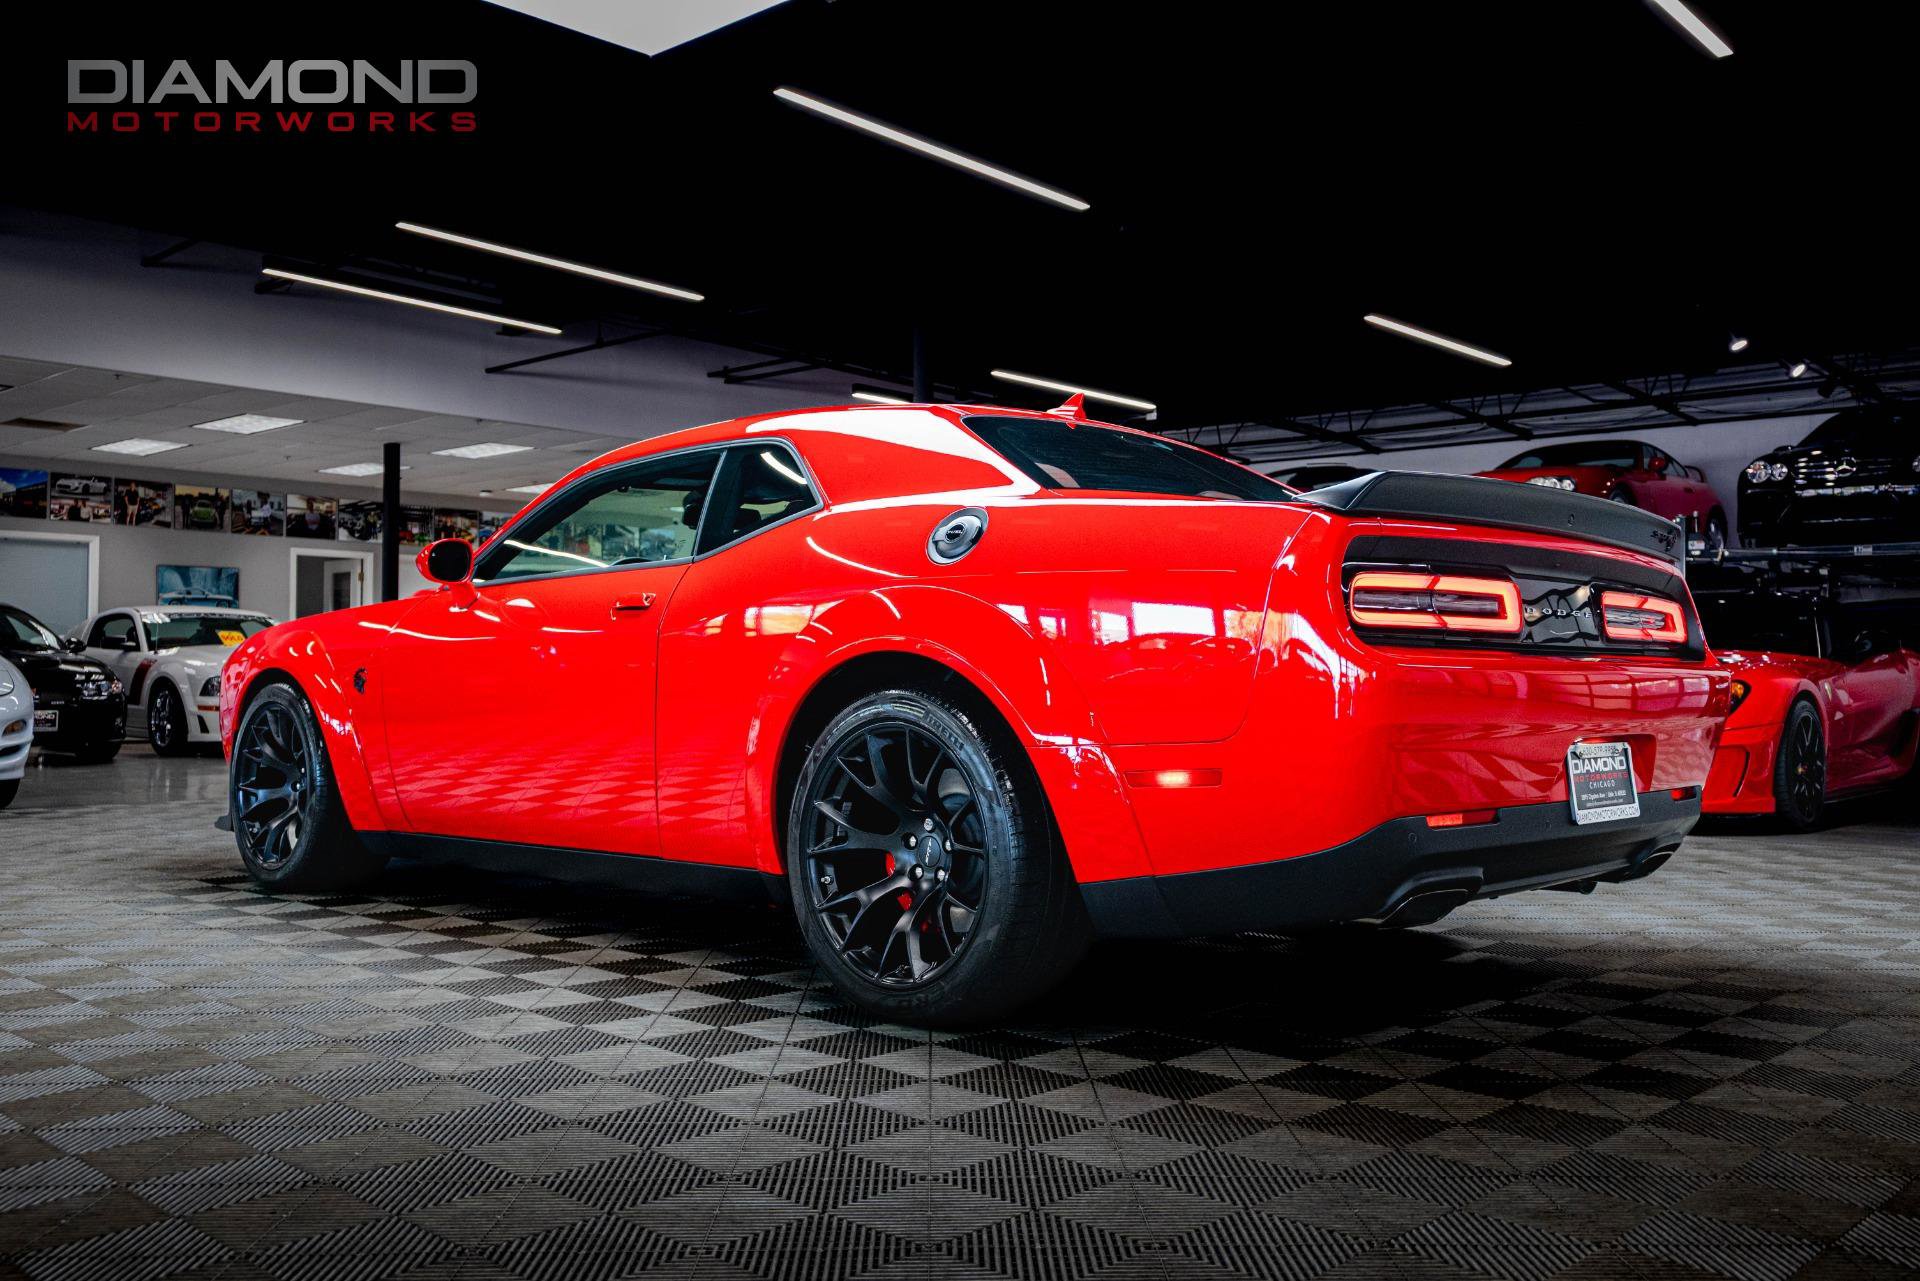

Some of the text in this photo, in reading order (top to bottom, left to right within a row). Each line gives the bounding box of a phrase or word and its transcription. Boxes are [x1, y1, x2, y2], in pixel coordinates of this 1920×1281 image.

[1525, 606, 1592, 619] DODGE
[1571, 757, 1626, 774] DIAMOND
[1589, 780, 1616, 789] CHICAGO
